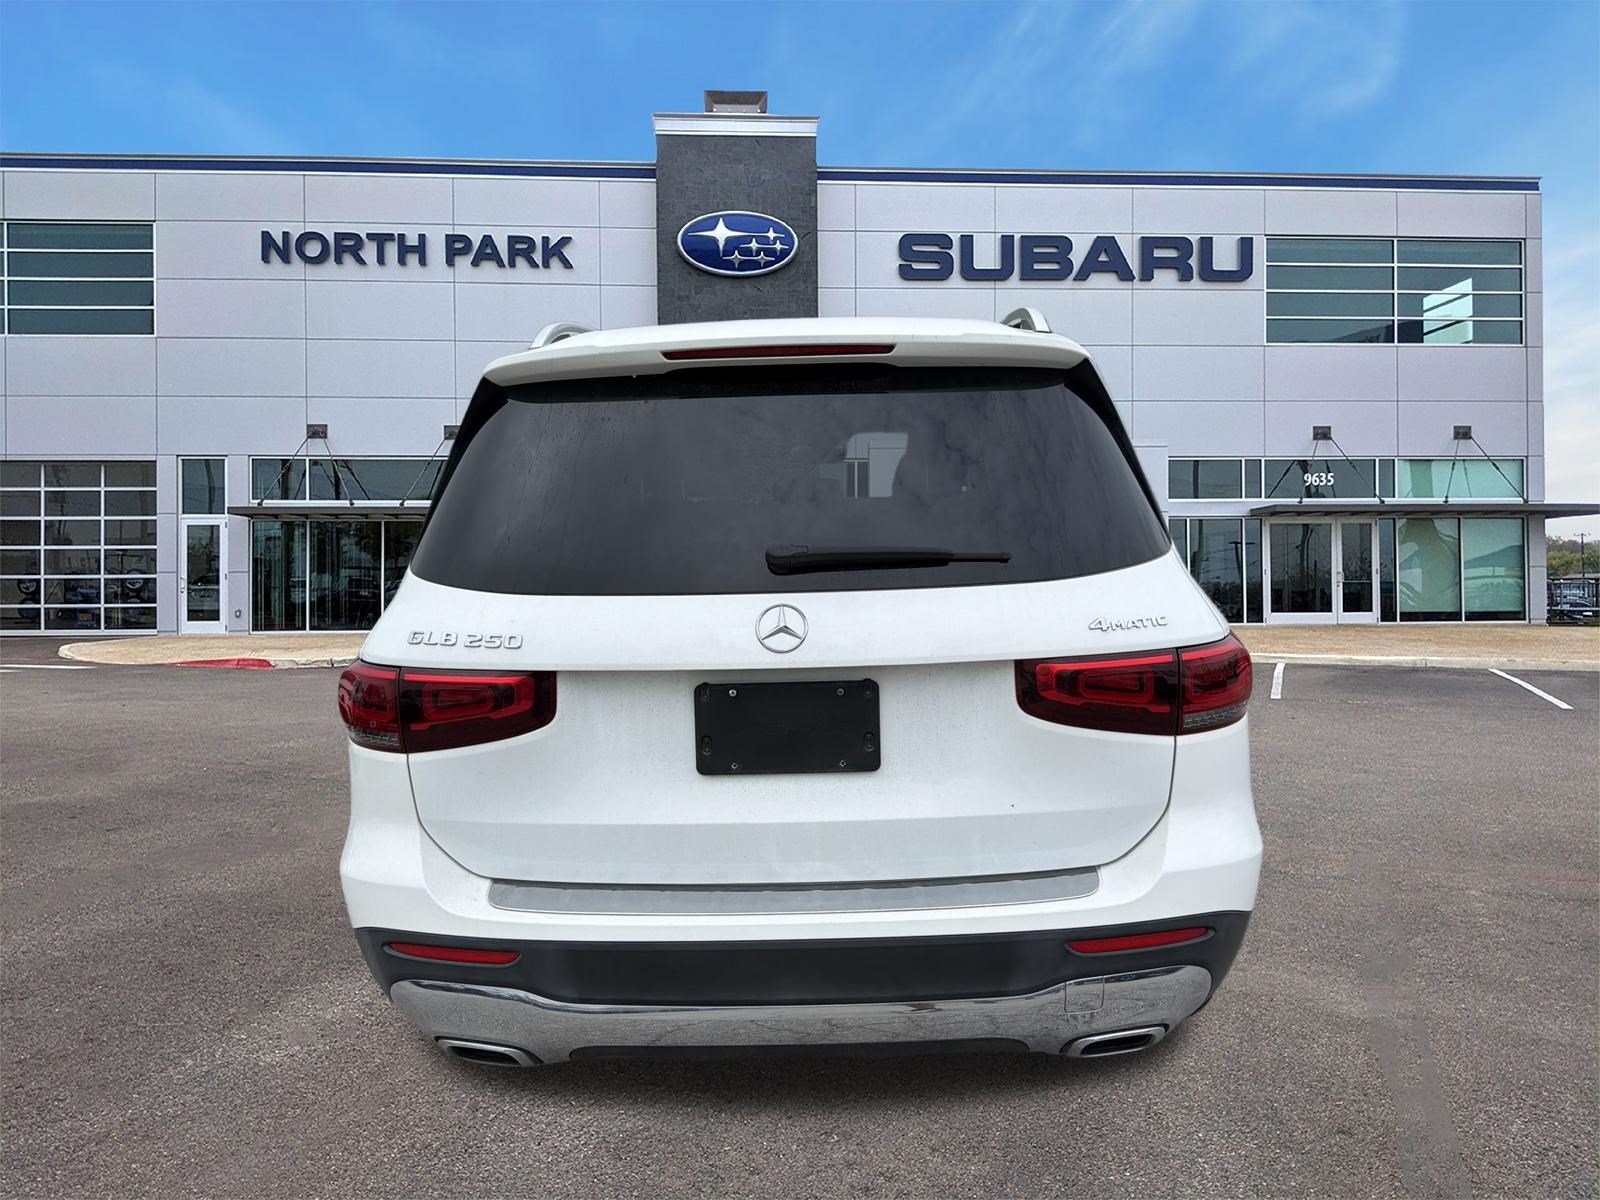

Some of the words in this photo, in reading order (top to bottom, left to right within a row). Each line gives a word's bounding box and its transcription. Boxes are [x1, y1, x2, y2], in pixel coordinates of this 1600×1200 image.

[261, 230, 428, 266] NORTH
[445, 233, 574, 269] PARK
[898, 232, 1255, 283] SUBARU
[1303, 472, 1335, 486] 9635
[1087, 616, 1168, 632] 4MATIC
[407, 631, 459, 647] GLB
[463, 632, 523, 650] 250
